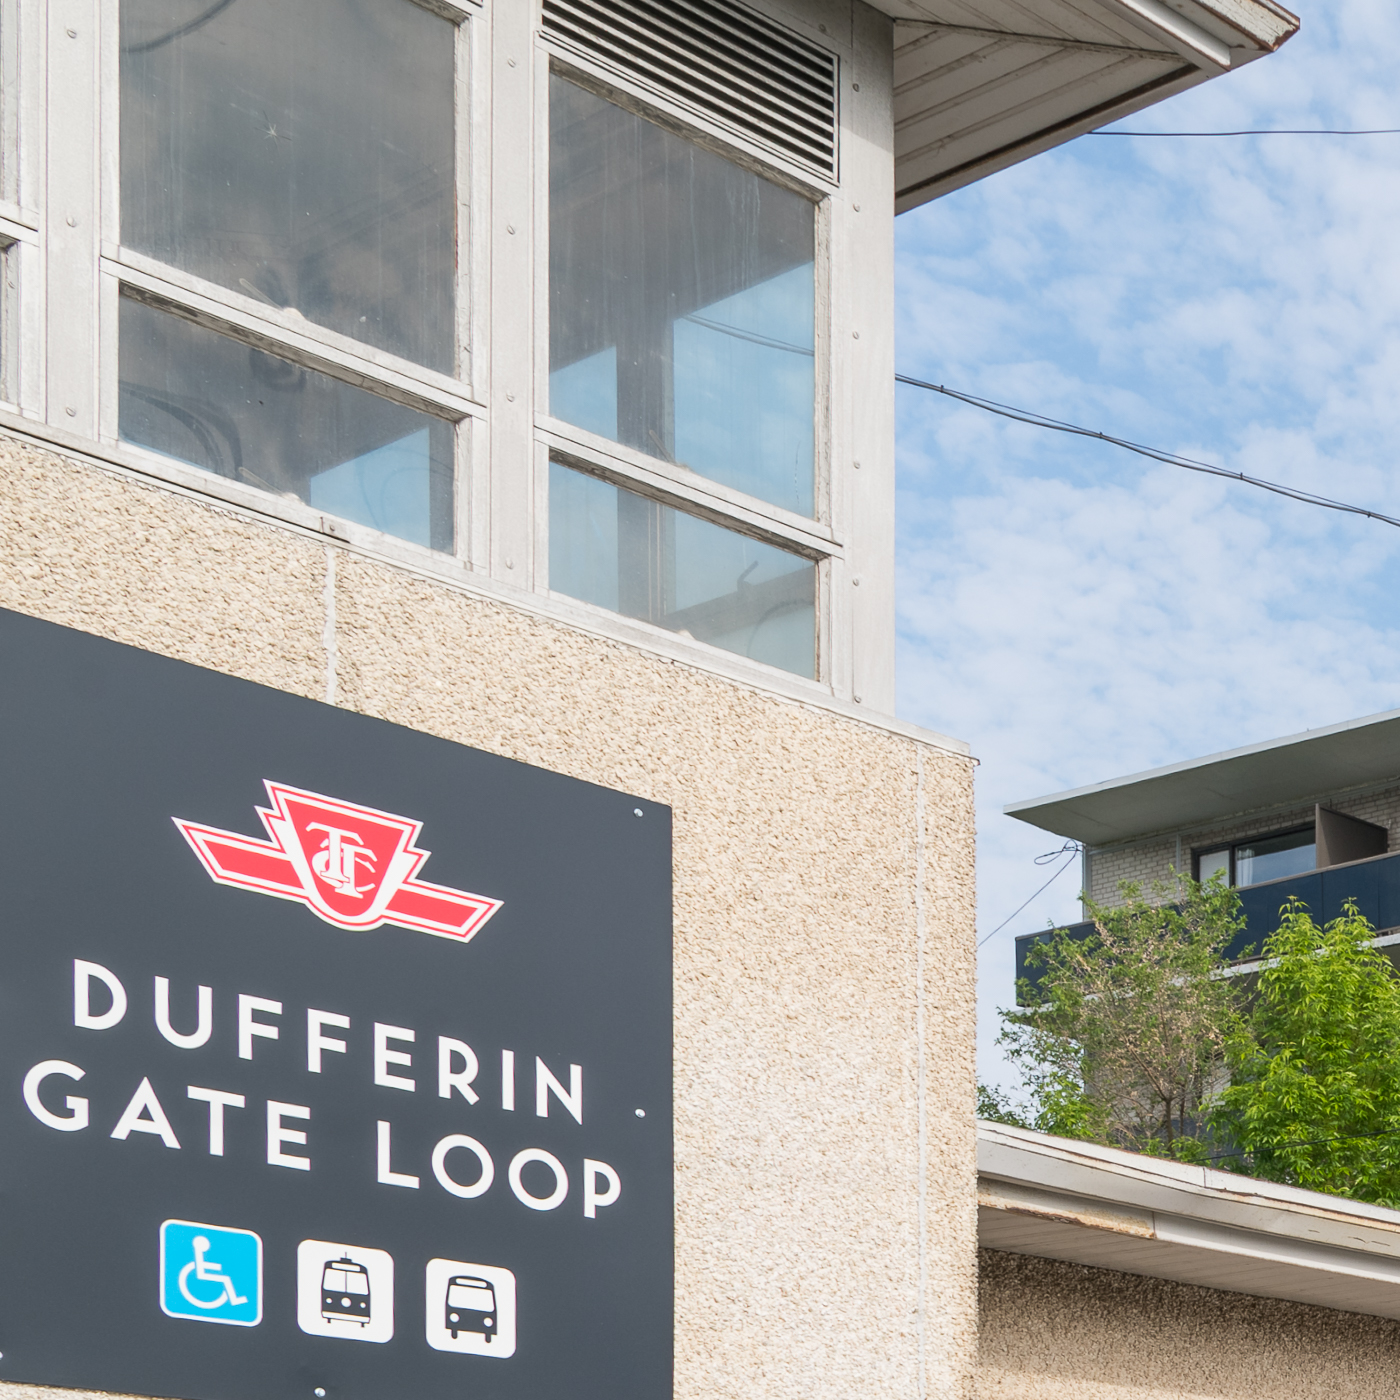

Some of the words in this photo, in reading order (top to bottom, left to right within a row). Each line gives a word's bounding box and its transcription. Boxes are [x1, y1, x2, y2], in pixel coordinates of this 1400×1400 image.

[73, 958, 584, 1125] DUFFERIN
[22, 1059, 312, 1172] GATE
[377, 1120, 622, 1219] LOOP
